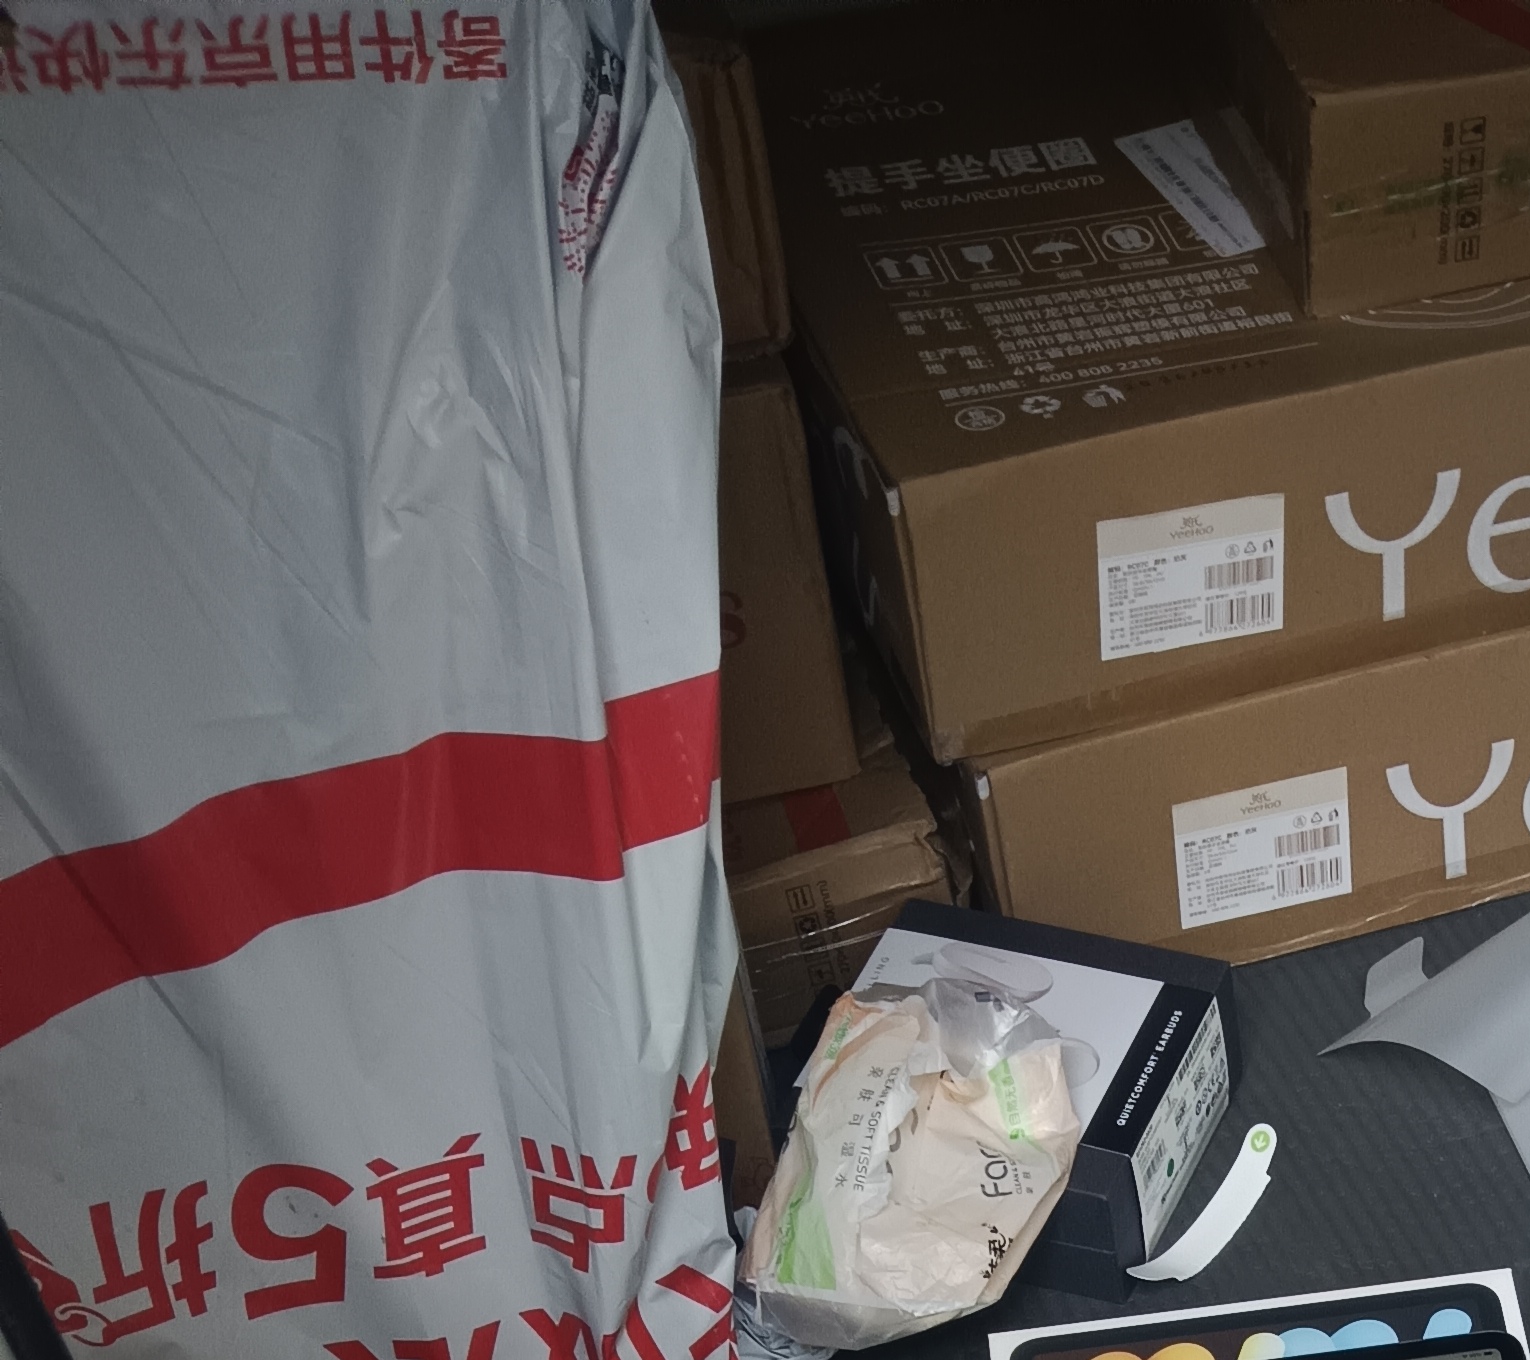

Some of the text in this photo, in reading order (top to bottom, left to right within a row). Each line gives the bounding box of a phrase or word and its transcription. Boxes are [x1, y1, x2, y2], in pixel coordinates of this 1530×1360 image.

[2, 12, 507, 94] 寄件用京东快
[824, 136, 1098, 199] 提手坐便圈
[1116, 1009, 1183, 1127] QUIETCOMFORT EARBUDS
[862, 1110, 883, 1141] SOFT
[852, 1144, 873, 1194] TISSUE
